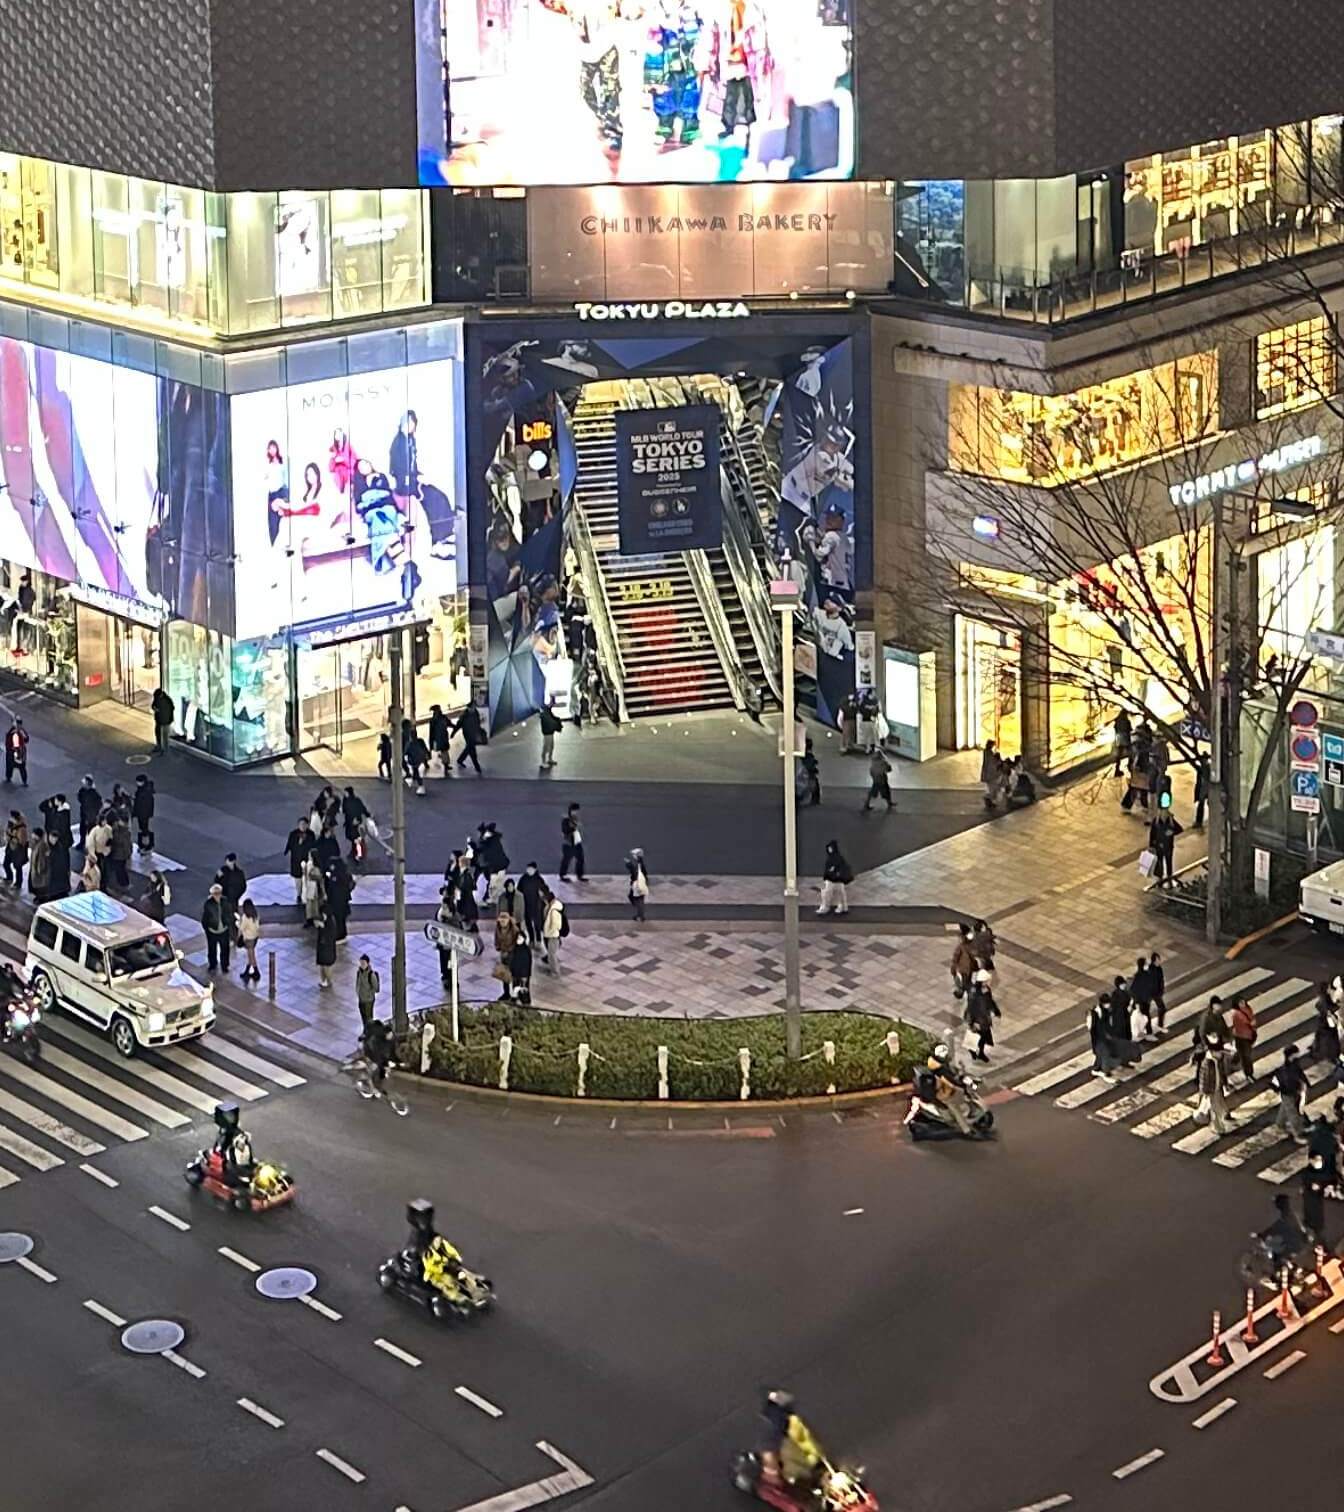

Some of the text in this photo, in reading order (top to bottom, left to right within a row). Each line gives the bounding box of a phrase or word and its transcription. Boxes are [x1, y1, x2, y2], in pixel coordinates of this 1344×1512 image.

[580, 212, 838, 236] CHIIKAWA BAKERY
[574, 301, 750, 320] TOKYU PLAZA
[522, 421, 553, 443] bills
[650, 431, 681, 443] WORLD
[682, 429, 704, 440] TOUR
[632, 439, 703, 459] TOKYO
[631, 453, 707, 474] SERIES
